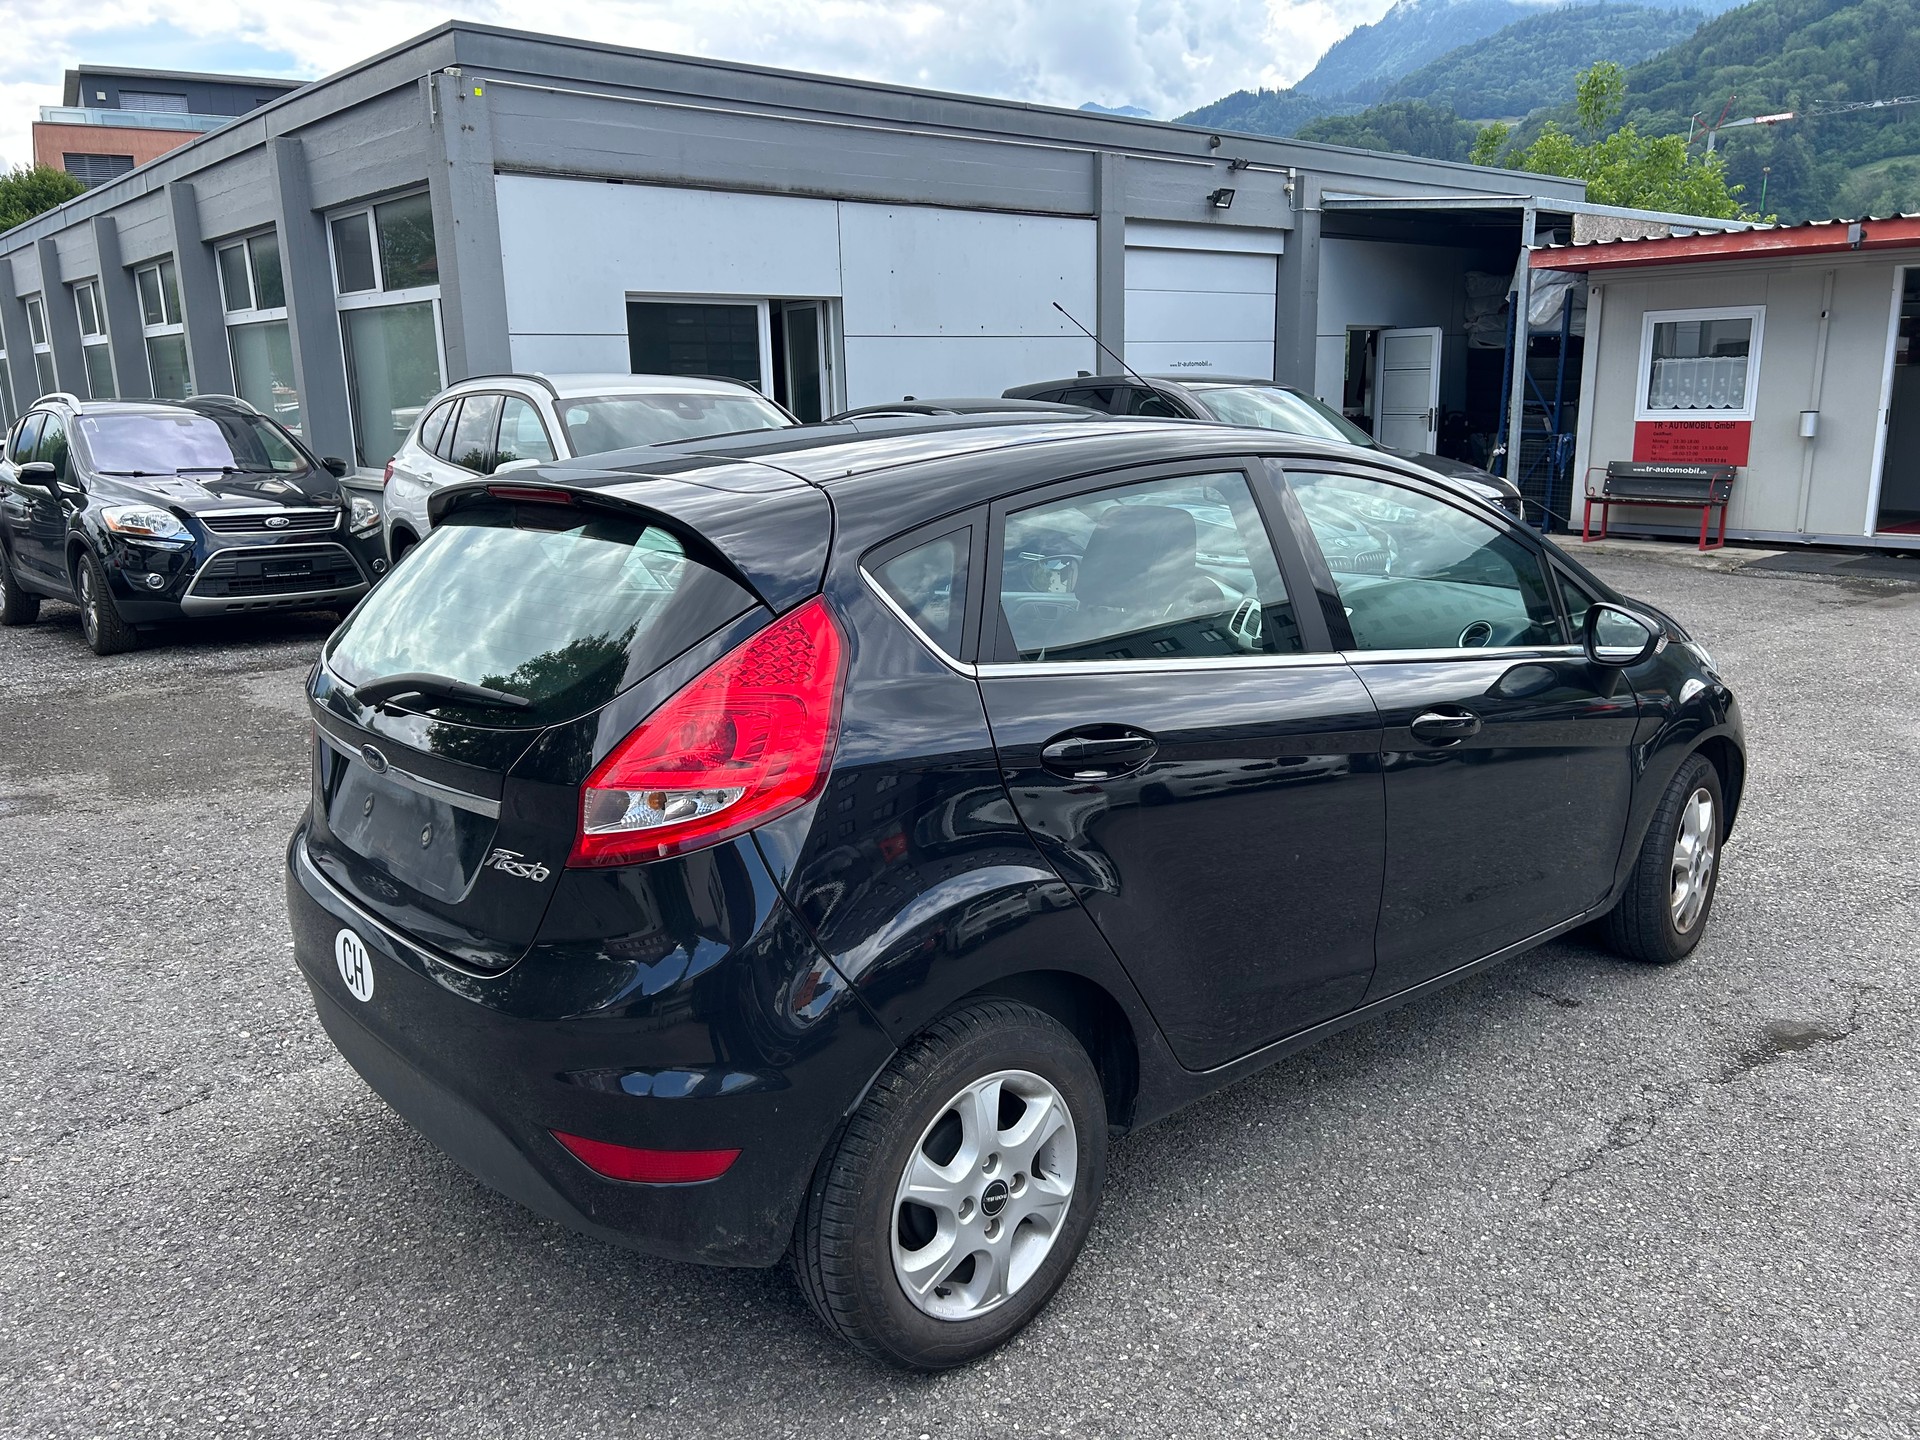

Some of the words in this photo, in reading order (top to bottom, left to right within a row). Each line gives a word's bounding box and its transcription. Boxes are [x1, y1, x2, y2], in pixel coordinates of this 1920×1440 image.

[1668, 421, 1712, 429] AUTOMOBIL
[1714, 421, 1736, 430] GmbH
[1632, 465, 1708, 475] www.tr-automobil.ch
[484, 848, 550, 882] Fiesta
[343, 936, 366, 996] CH
